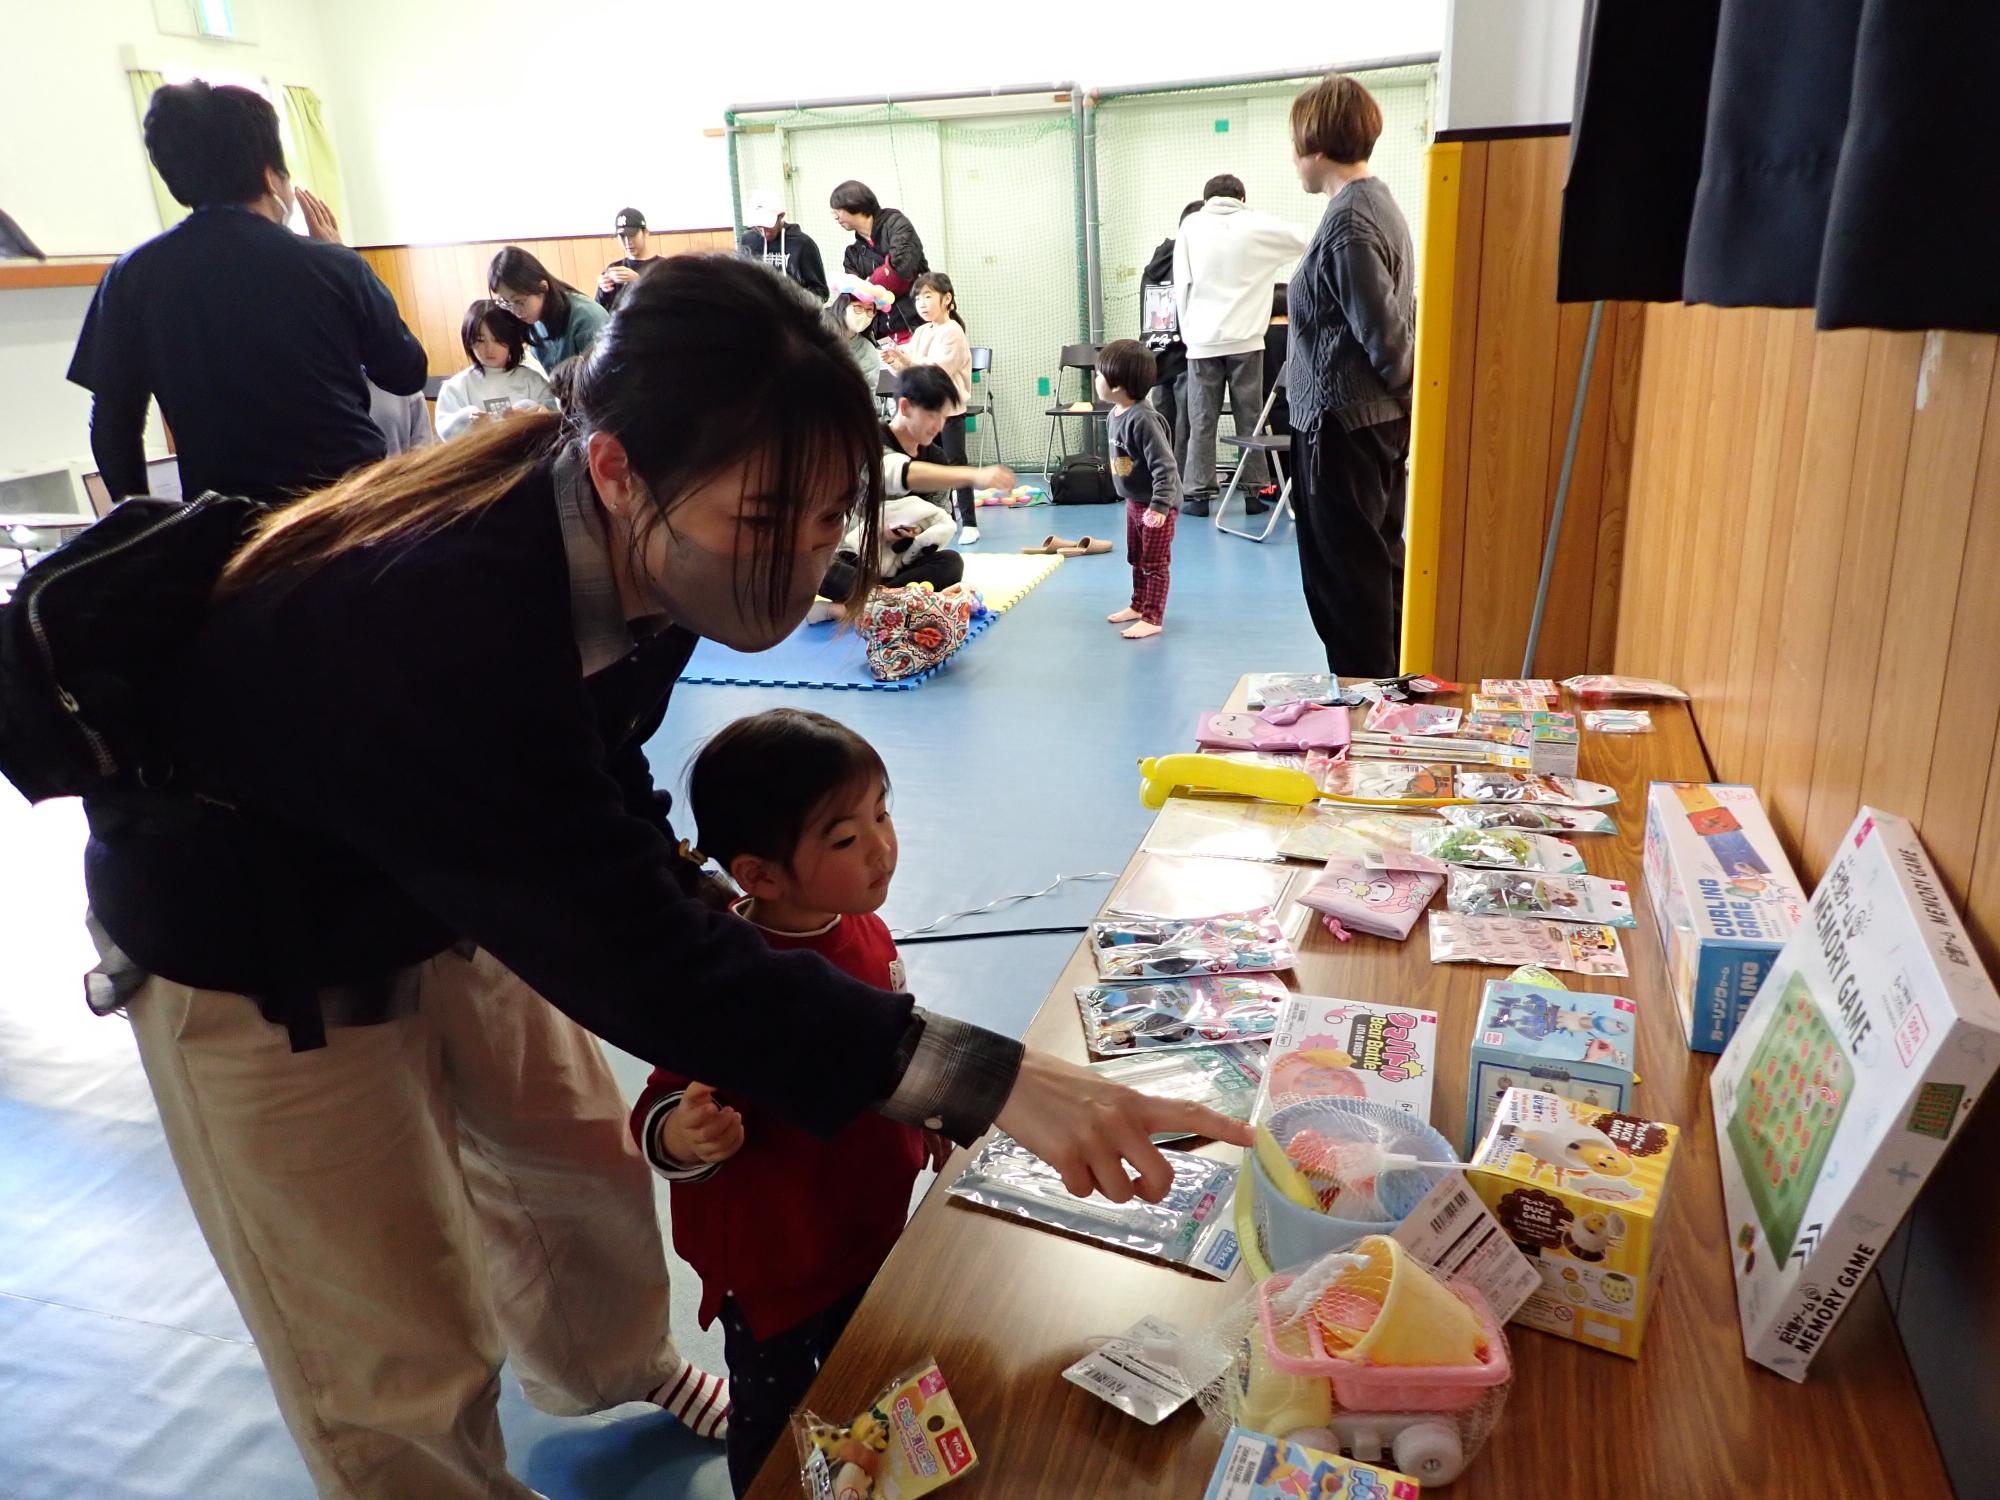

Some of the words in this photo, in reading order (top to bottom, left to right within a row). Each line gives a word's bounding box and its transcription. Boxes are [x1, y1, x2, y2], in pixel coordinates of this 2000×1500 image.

[1698, 878, 1736, 937] CURLING
[1731, 902, 1762, 939] GAME
[1813, 888, 1850, 984] MEMORY
[1837, 975, 1873, 1056] GAME
[1369, 1016, 1387, 1041] Bear
[1363, 1039, 1384, 1070] Battle
[1378, 1012, 1420, 1082] クマバトル
[1608, 1119, 1625, 1139] GAME
[1619, 1122, 1636, 1142] DUCK
[1522, 1204, 1552, 1217] DUCK
[1522, 1211, 1551, 1225] GAME
[1794, 1290, 1842, 1354] MEMORY
[1837, 1243, 1876, 1293] GAME
